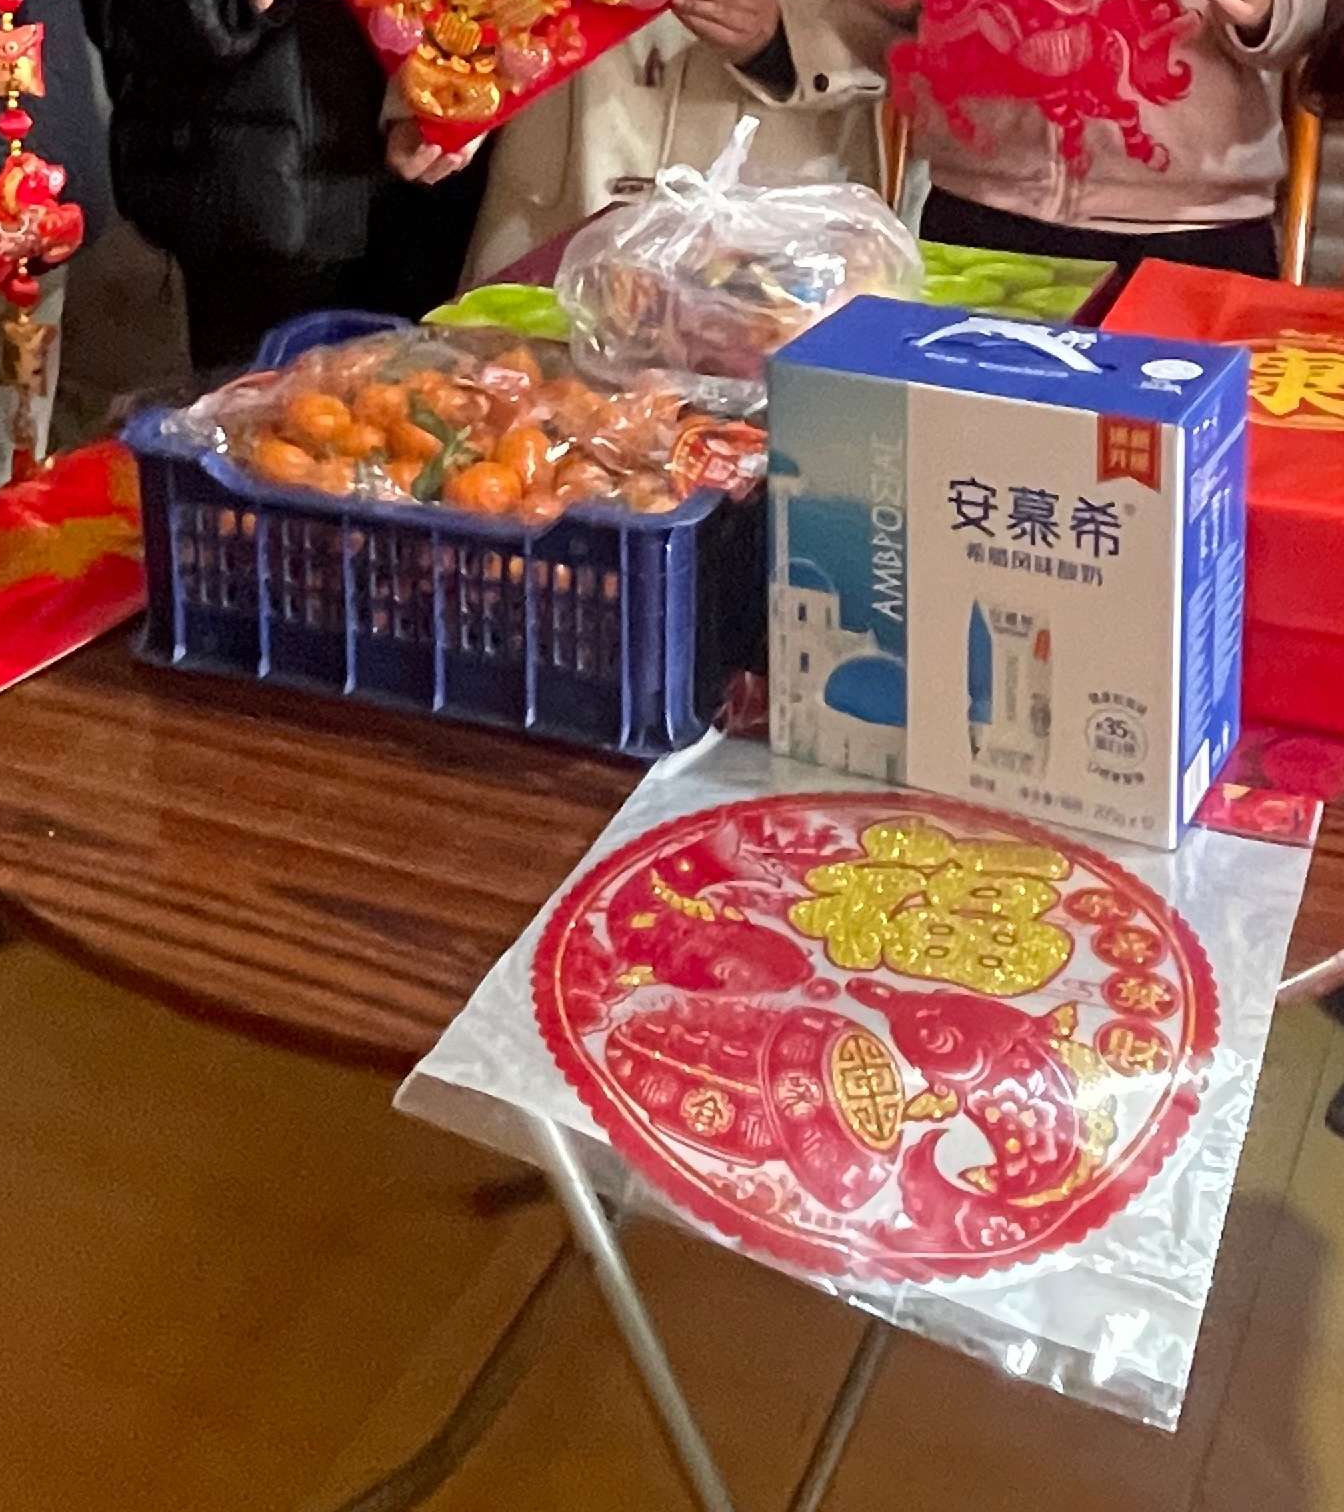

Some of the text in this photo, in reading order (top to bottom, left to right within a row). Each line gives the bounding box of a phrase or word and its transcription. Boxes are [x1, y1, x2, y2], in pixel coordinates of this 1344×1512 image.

[948, 476, 1122, 558] 安慕希
[787, 816, 1075, 996] 福
